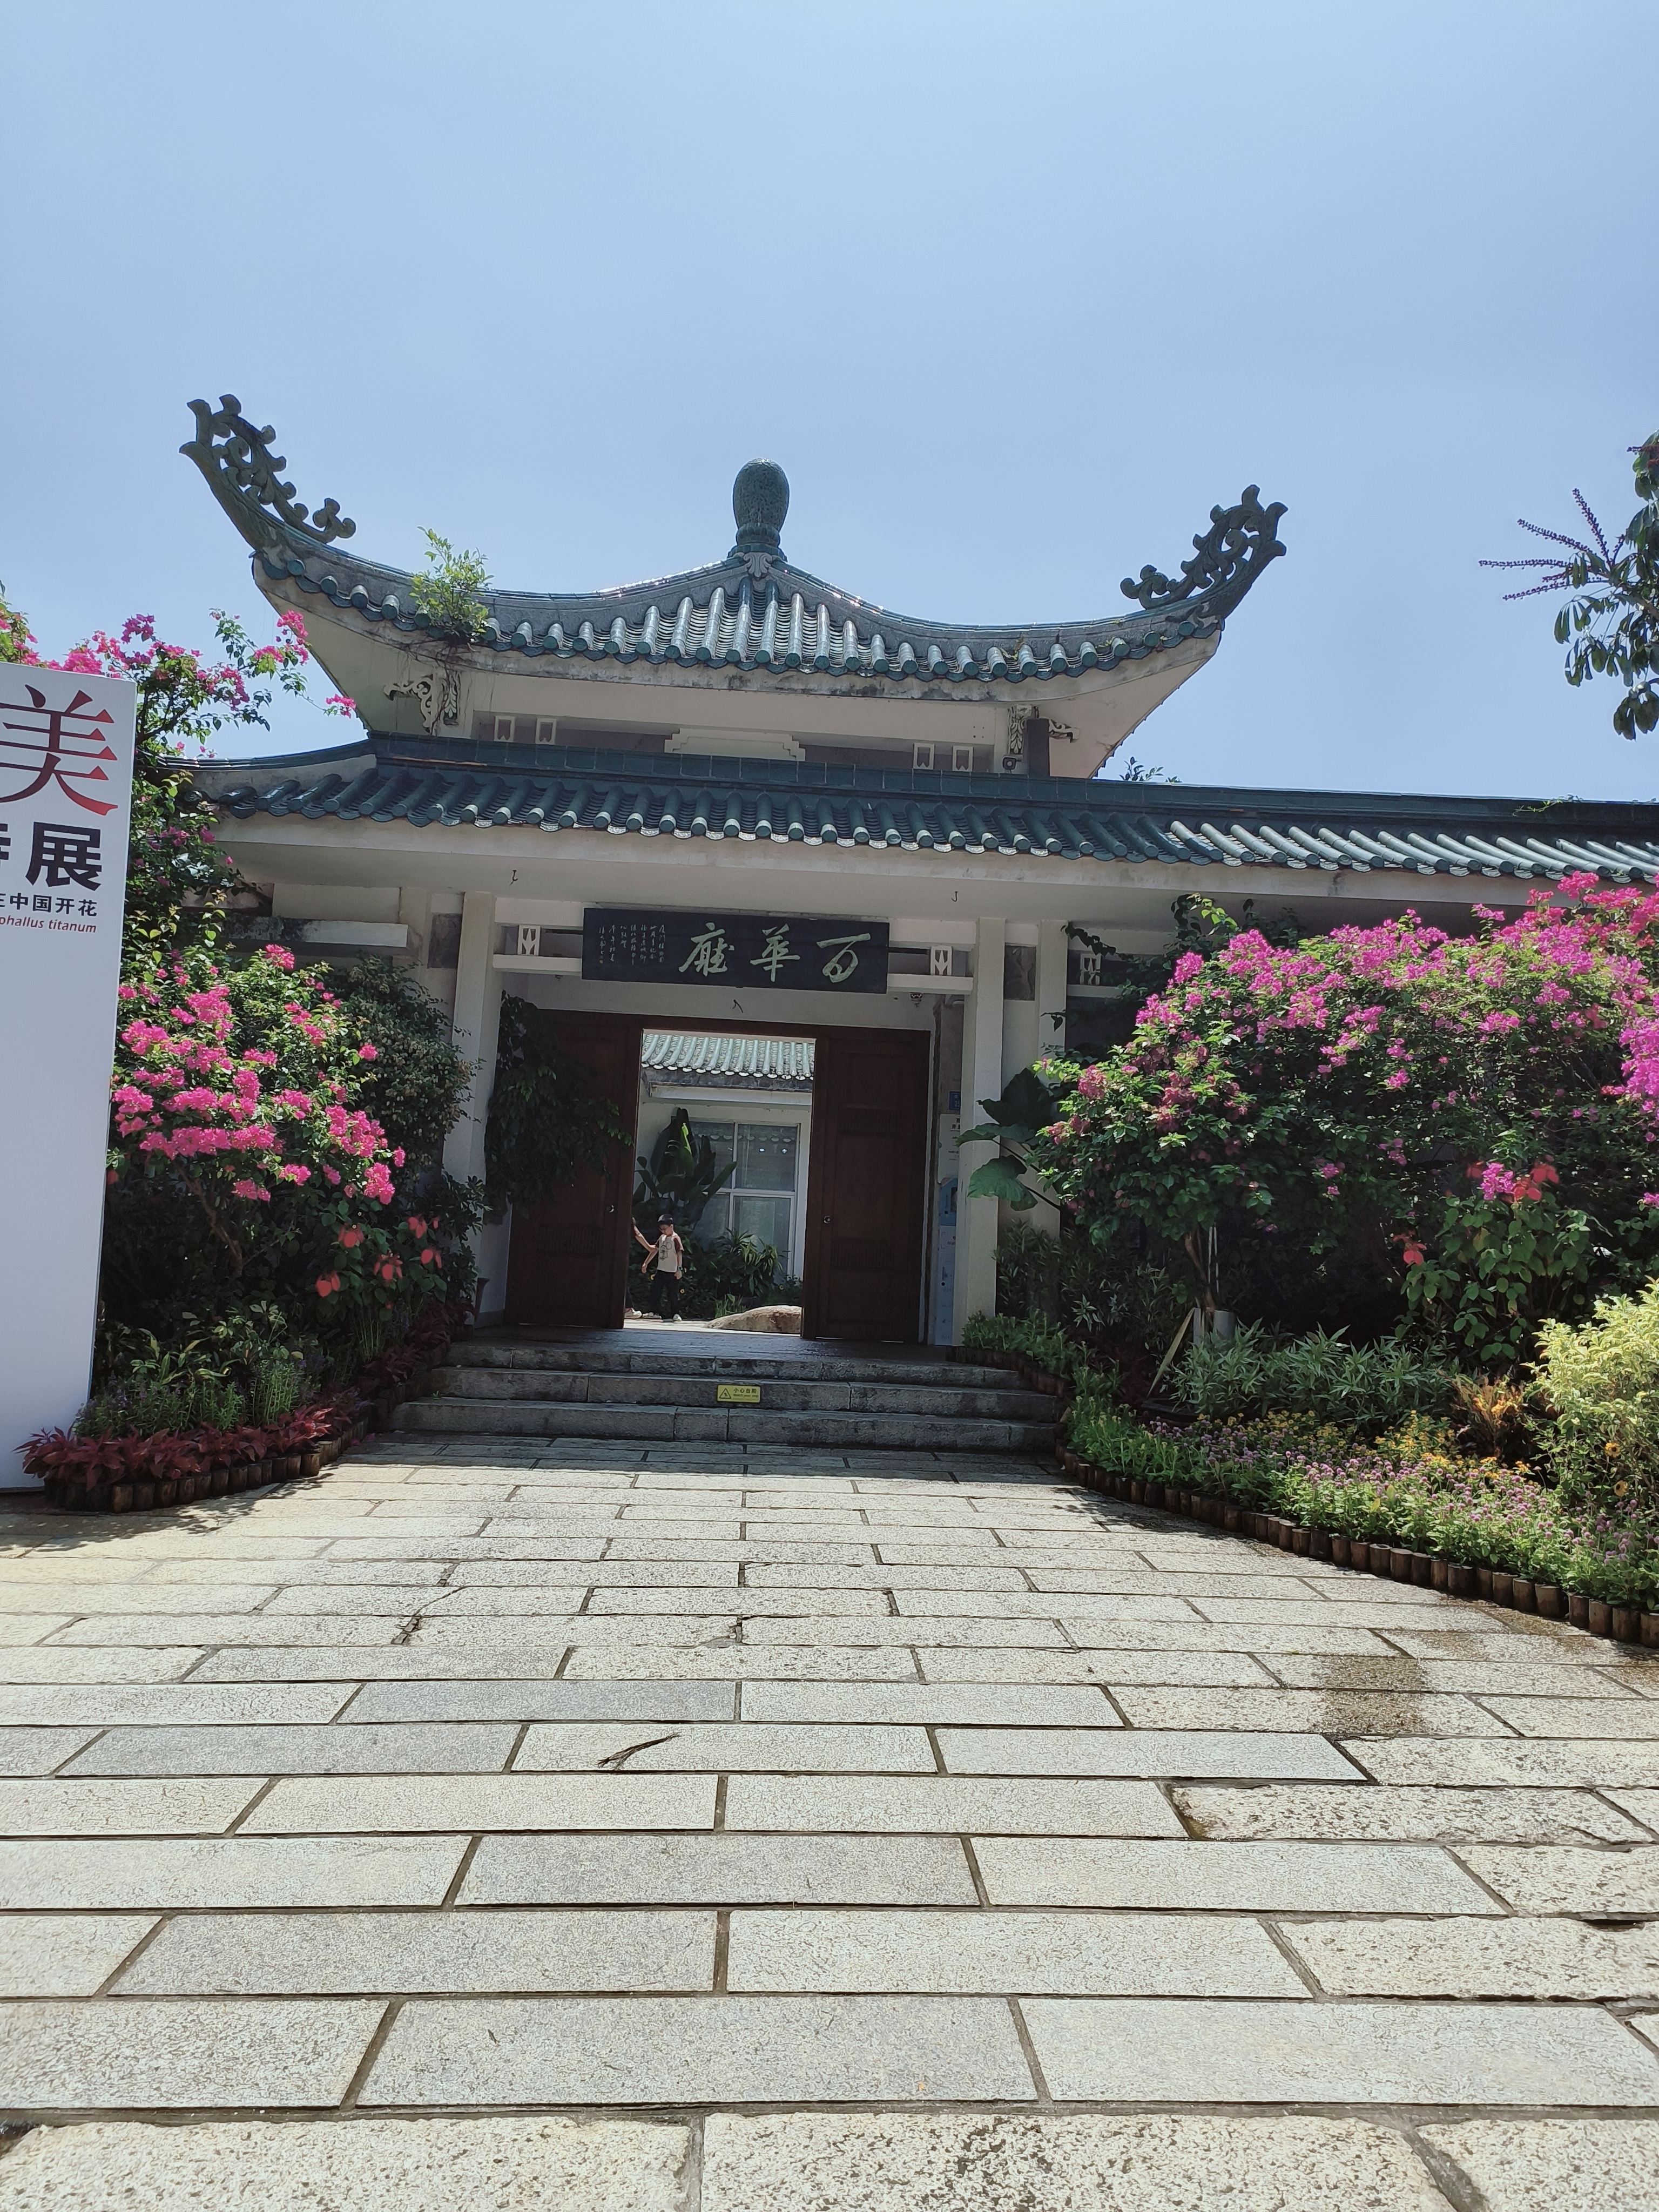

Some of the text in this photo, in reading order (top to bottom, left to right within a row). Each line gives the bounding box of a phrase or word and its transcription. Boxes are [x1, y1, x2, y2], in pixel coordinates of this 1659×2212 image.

[0, 684, 118, 816] 美
[0, 821, 103, 892] 展
[49, 919, 97, 933] titanum
